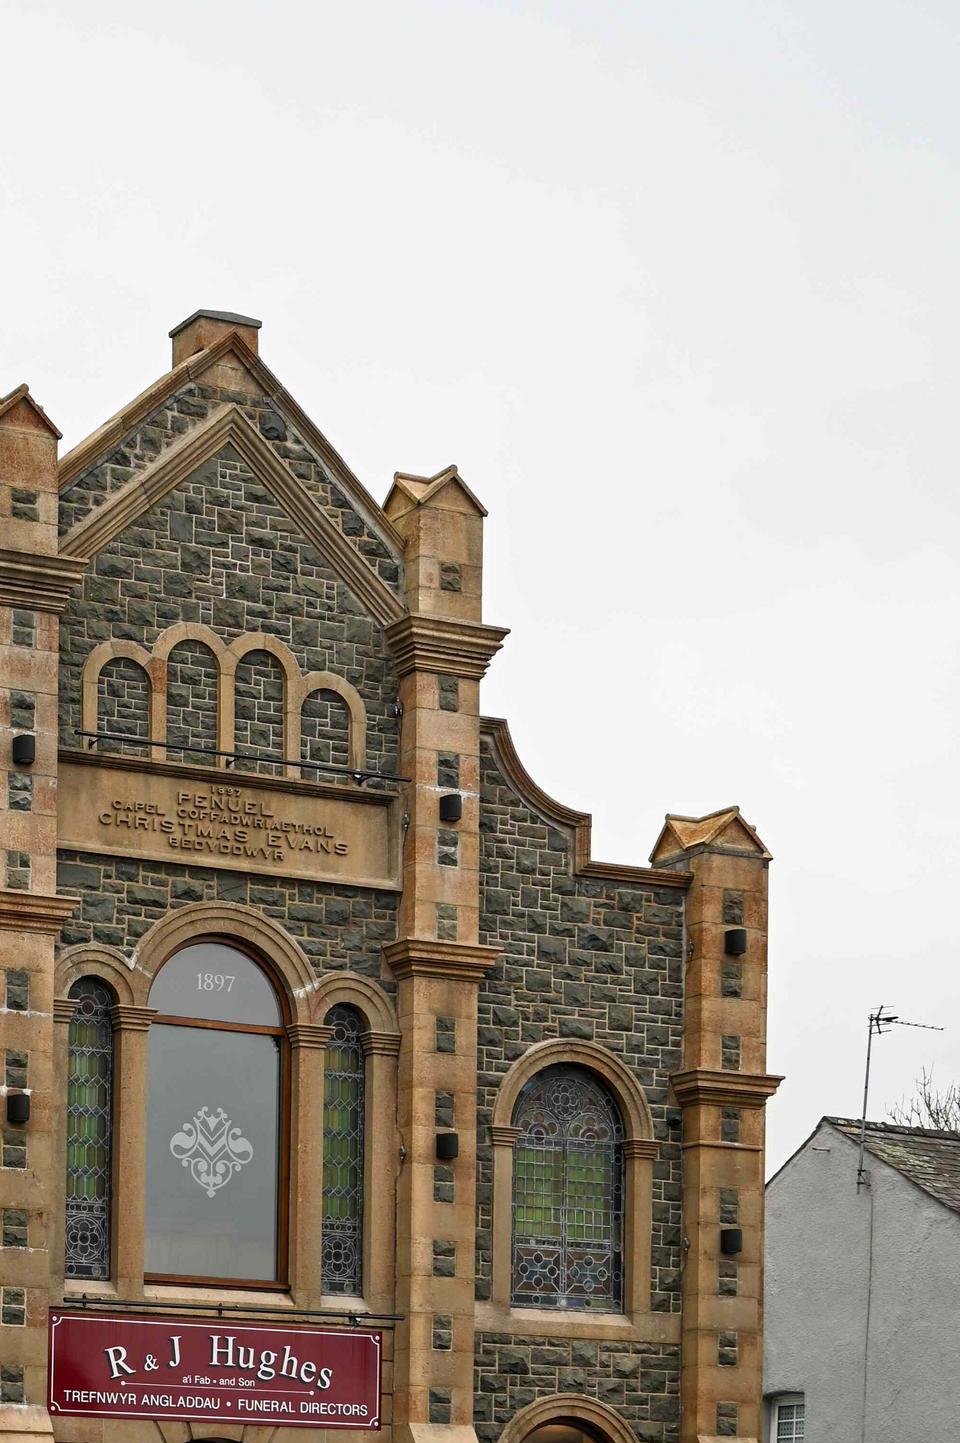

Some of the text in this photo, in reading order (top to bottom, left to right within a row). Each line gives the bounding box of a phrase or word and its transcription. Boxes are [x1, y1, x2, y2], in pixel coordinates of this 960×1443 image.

[178, 792, 274, 818] PENUEL
[210, 786, 242, 798] 1897
[112, 800, 334, 838] CAPEL COFFADWRIAETHOL
[98, 811, 348, 856] CHRISTMAS EVANS
[168, 836, 284, 861] BEDYDDWYR
[196, 973, 236, 992] 1897
[104, 1335, 333, 1389] R & J Hughes
[182, 1376, 255, 1387] a'i Fab and Son
[64, 1390, 368, 1416] TREFNWYR ANGLADDAU FUNERAL DIRECTORS
